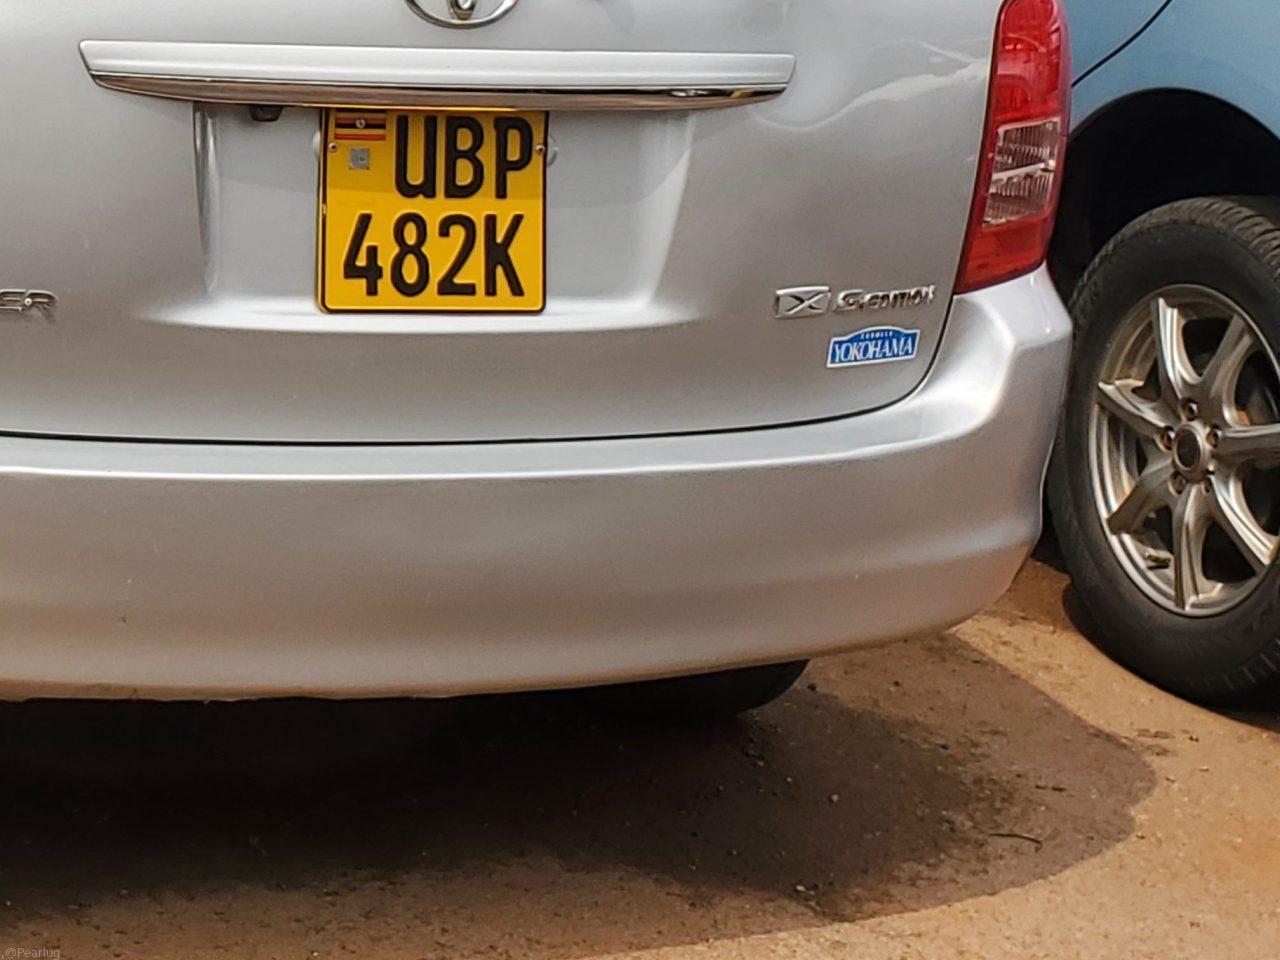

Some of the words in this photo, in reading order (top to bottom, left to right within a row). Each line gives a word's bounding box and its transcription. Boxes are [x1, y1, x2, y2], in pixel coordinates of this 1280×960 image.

[394, 114, 534, 199] UBP
[342, 211, 526, 297] 482K
[834, 335, 914, 363] YOKOHAMA
